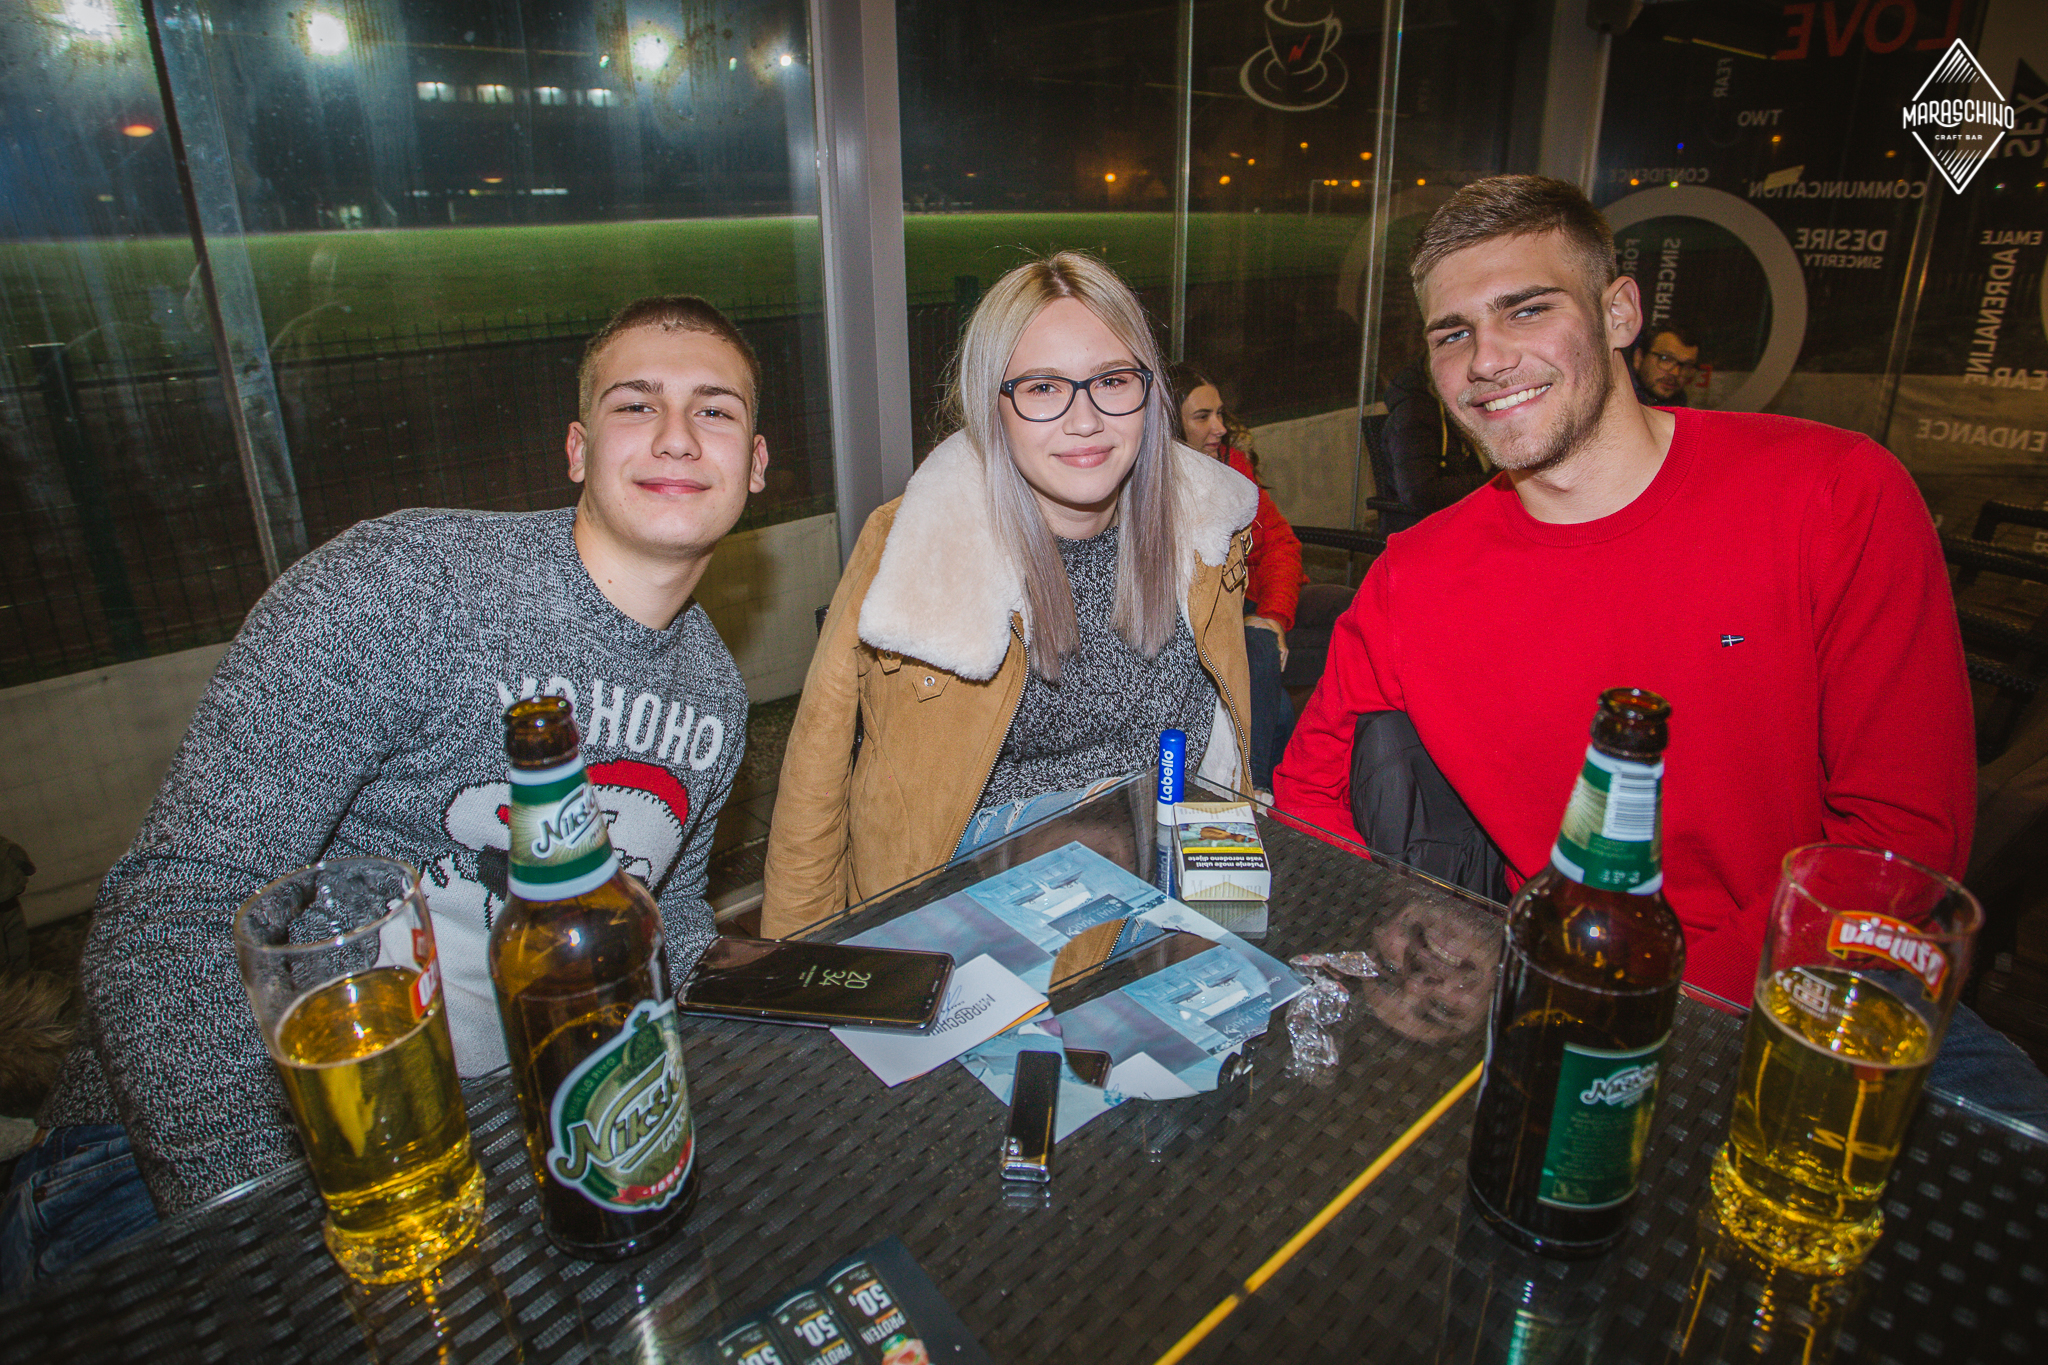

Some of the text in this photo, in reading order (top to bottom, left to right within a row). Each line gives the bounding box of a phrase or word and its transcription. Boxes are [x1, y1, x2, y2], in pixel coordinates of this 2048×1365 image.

[1160, 749, 1174, 802] Labello
[818, 968, 847, 987] 34
[844, 970, 873, 989] 20
[860, 1310, 907, 1346] PROTEIN
